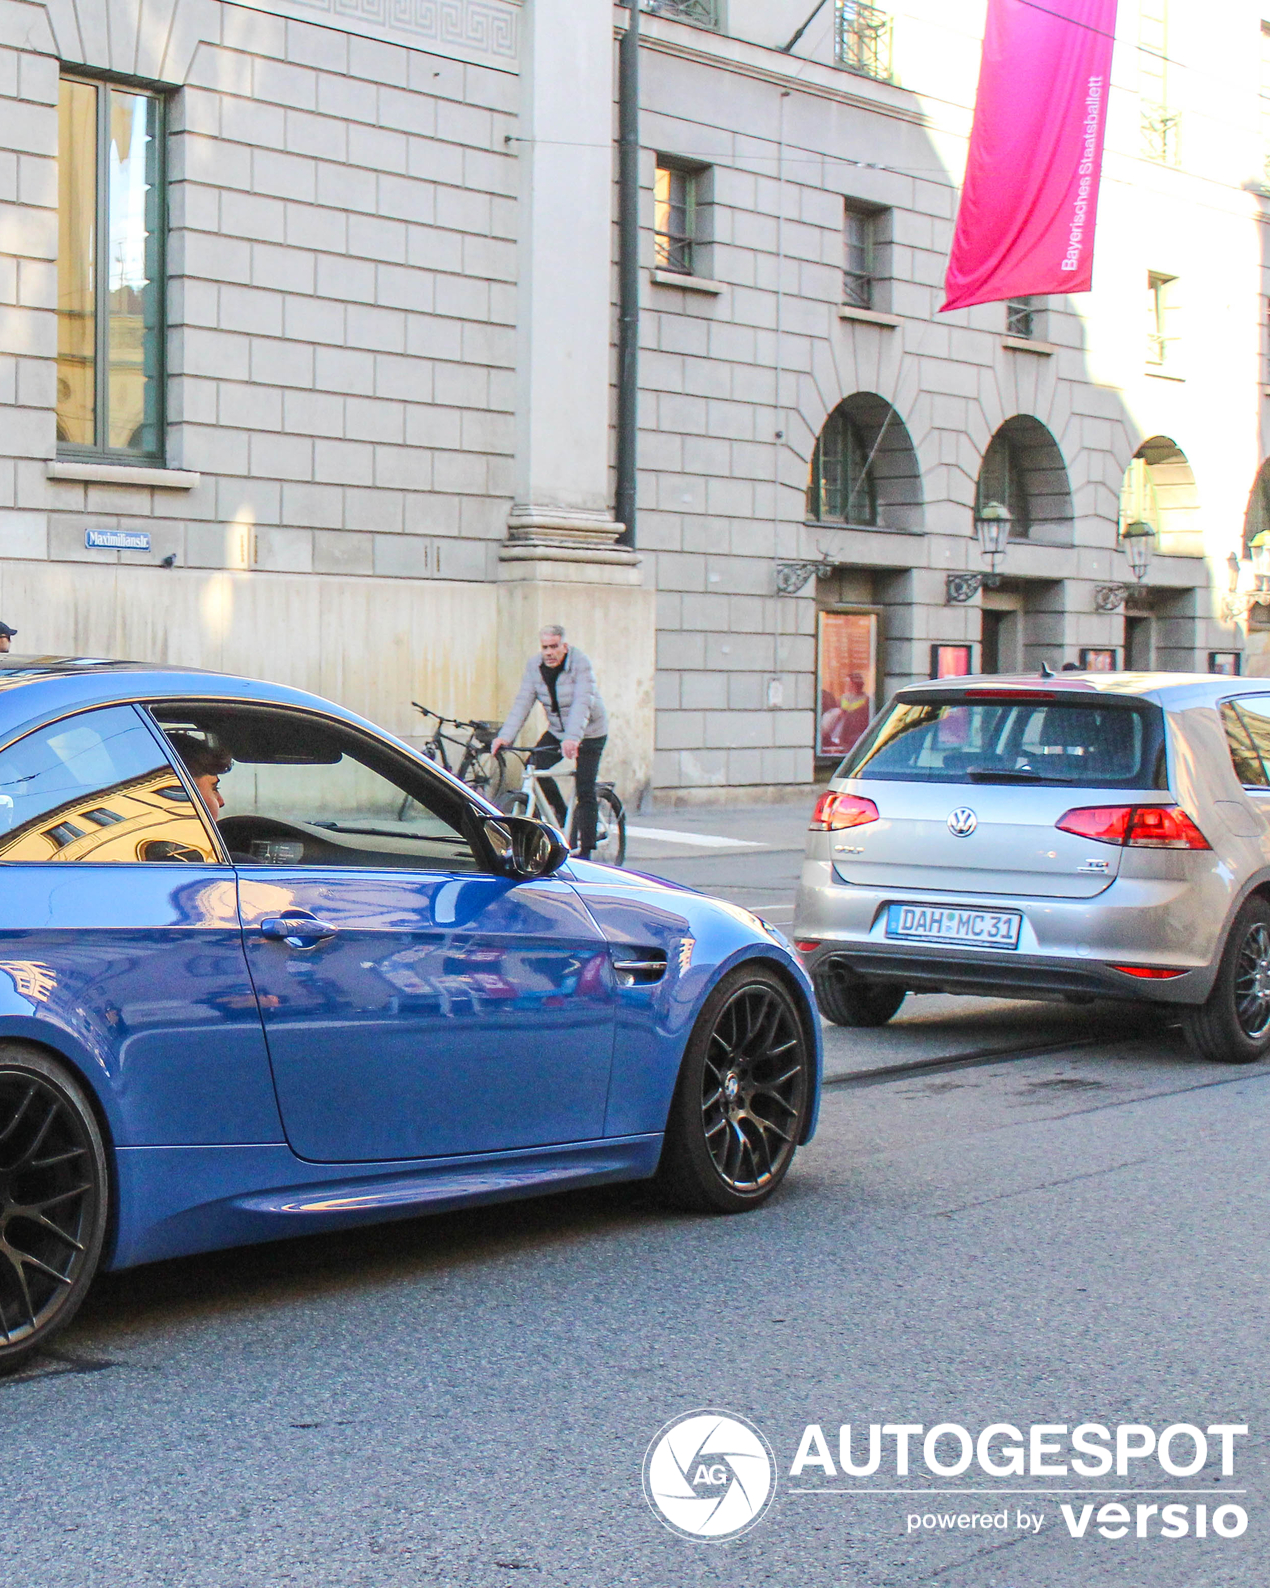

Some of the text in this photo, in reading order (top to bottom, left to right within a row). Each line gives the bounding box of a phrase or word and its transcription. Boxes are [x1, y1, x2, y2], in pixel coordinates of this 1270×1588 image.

[1061, 75, 1104, 271] Bayerisches Staatsballett
[89, 531, 149, 548] Maximilianstr.
[901, 908, 1013, 940] DAH MC 31
